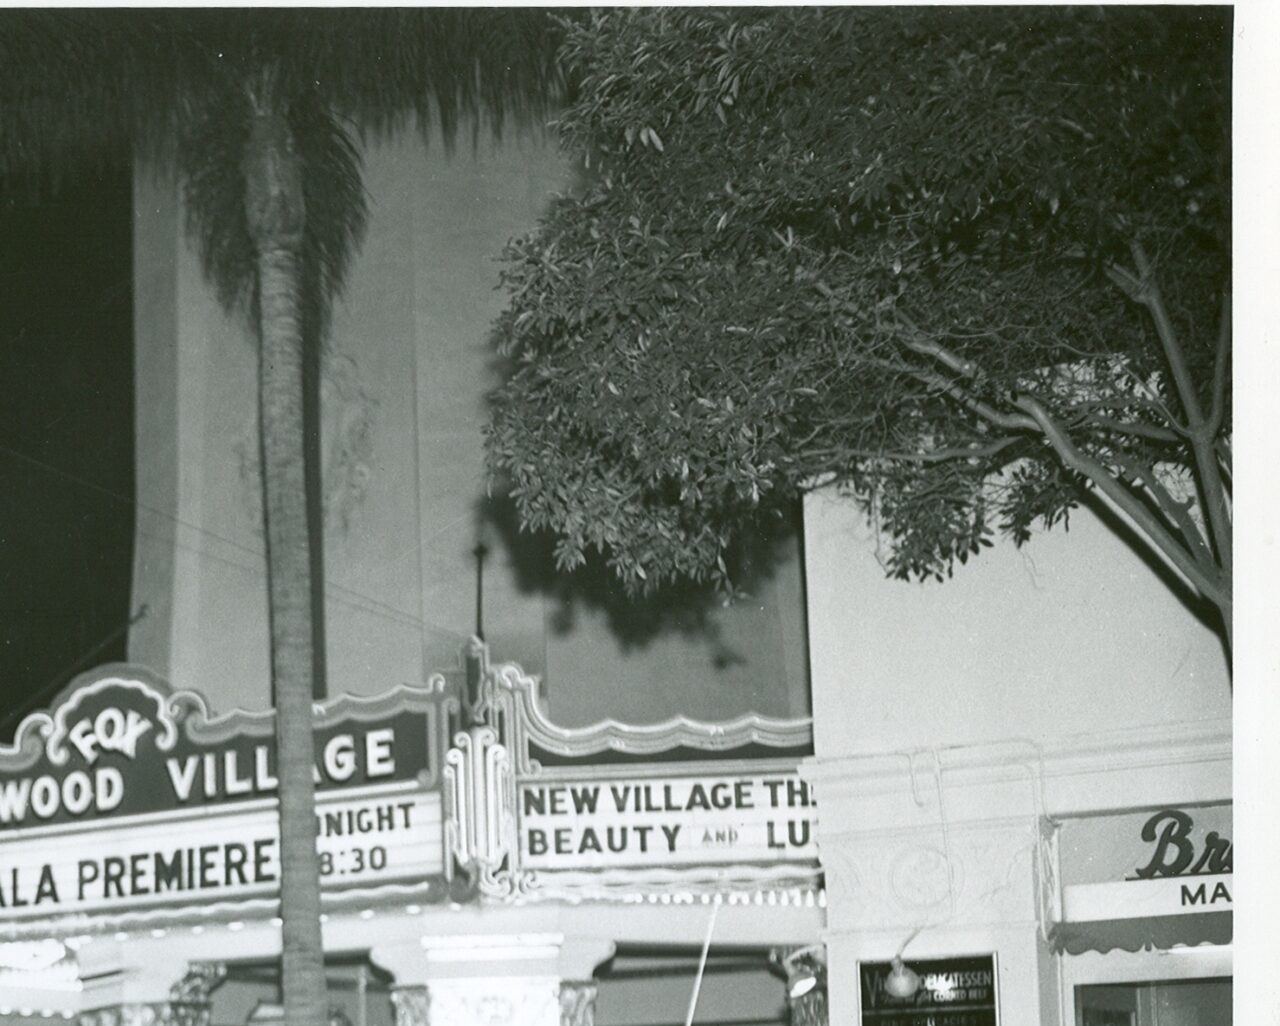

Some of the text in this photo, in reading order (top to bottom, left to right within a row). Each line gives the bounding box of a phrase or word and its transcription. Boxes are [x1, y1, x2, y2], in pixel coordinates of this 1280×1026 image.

[70, 707, 153, 764] FOX
[166, 728, 396, 800] VILLGE
[320, 802, 415, 838] NIGHT
[524, 779, 817, 816] NEW VILLAGE TH
[528, 819, 818, 856] BEAUTY AND LU
[1135, 809, 1233, 879] Br
[77, 838, 276, 901] PREMIERE
[320, 846, 387, 877] 8:30
